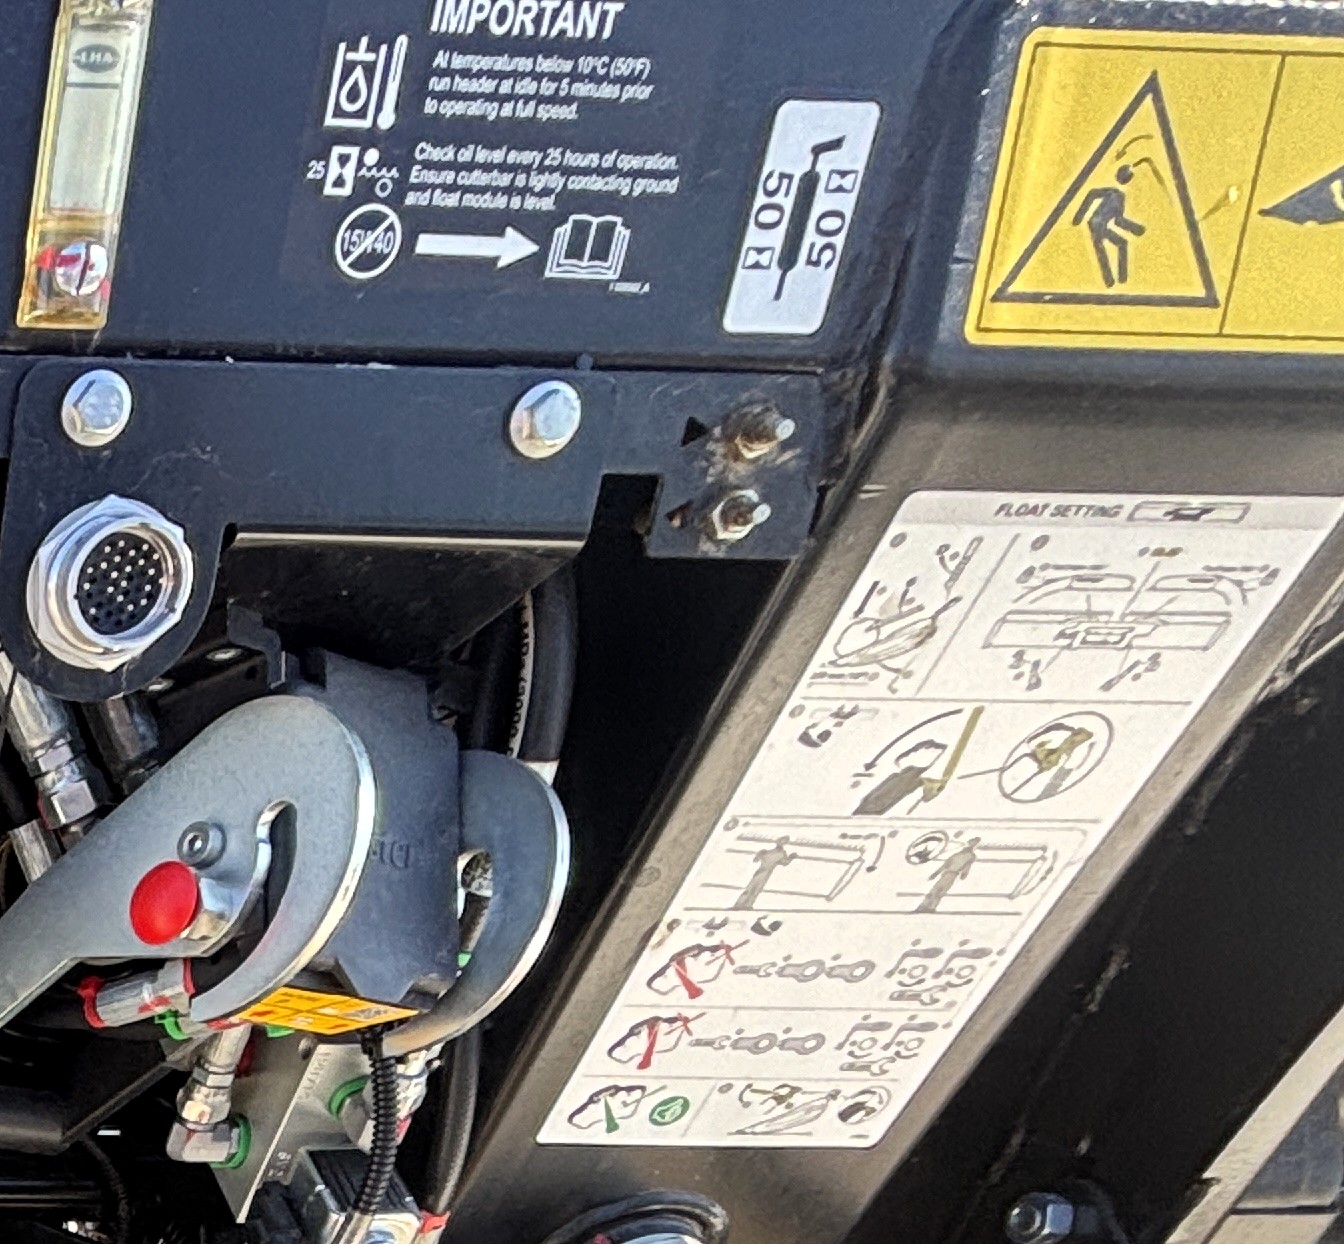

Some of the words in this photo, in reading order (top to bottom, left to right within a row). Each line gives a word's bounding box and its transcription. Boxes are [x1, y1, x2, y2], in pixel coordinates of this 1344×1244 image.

[429, 0, 625, 39] IMPORTANT
[431, 50, 449, 70] At
[450, 51, 534, 73] temperatures
[535, 54, 574, 74] below
[428, 76, 451, 92] run
[452, 75, 496, 94] header
[498, 77, 512, 94] at
[570, 79, 621, 99] minutes
[620, 80, 655, 103] prior
[423, 97, 438, 115] to
[438, 98, 499, 121] operating
[499, 100, 513, 118] at
[414, 141, 455, 161] Check
[475, 145, 507, 163] level
[506, 148, 543, 168] every
[544, 146, 564, 166] 25
[564, 149, 600, 168] hours
[601, 149, 618, 168] of
[307, 160, 325, 180] 25
[410, 165, 455, 184] Ensure
[567, 174, 632, 196] contacting
[633, 176, 680, 197] ground
[405, 188, 431, 206] and
[462, 190, 509, 209] module
[754, 169, 795, 230] 50
[805, 209, 846, 270] 50
[994, 503, 1049, 517] FLOAT
[1049, 503, 1124, 519] SETTING
